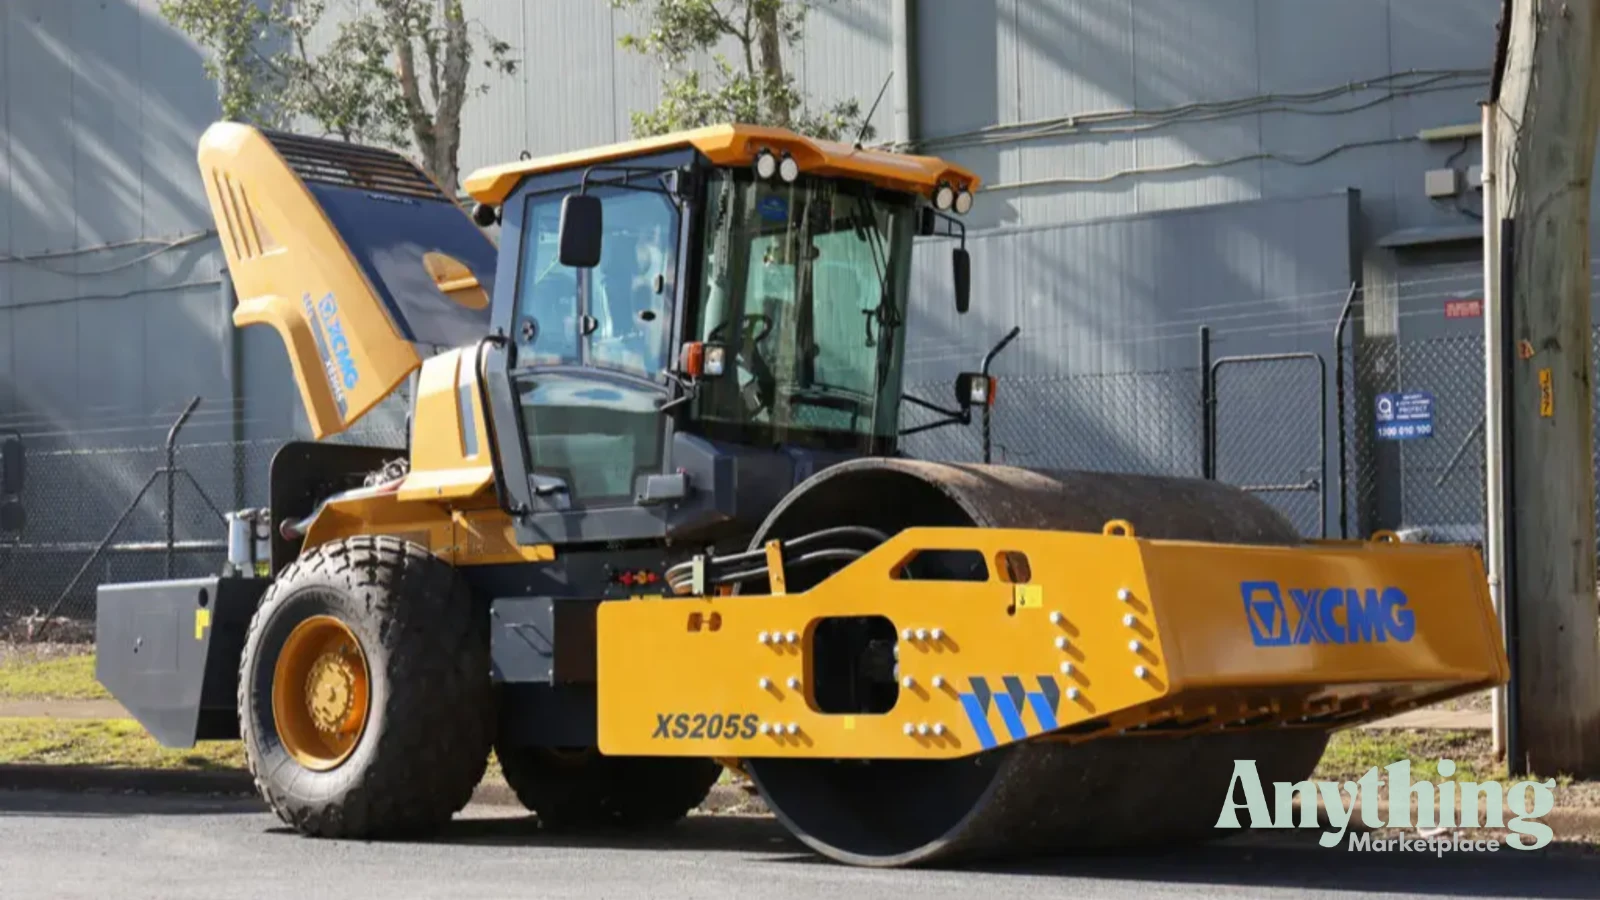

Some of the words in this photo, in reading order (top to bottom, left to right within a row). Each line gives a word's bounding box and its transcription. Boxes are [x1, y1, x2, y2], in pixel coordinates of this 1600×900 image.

[325, 317, 359, 391] XCMG
[1288, 586, 1416, 645] XCMG
[652, 713, 759, 740] XS205S
